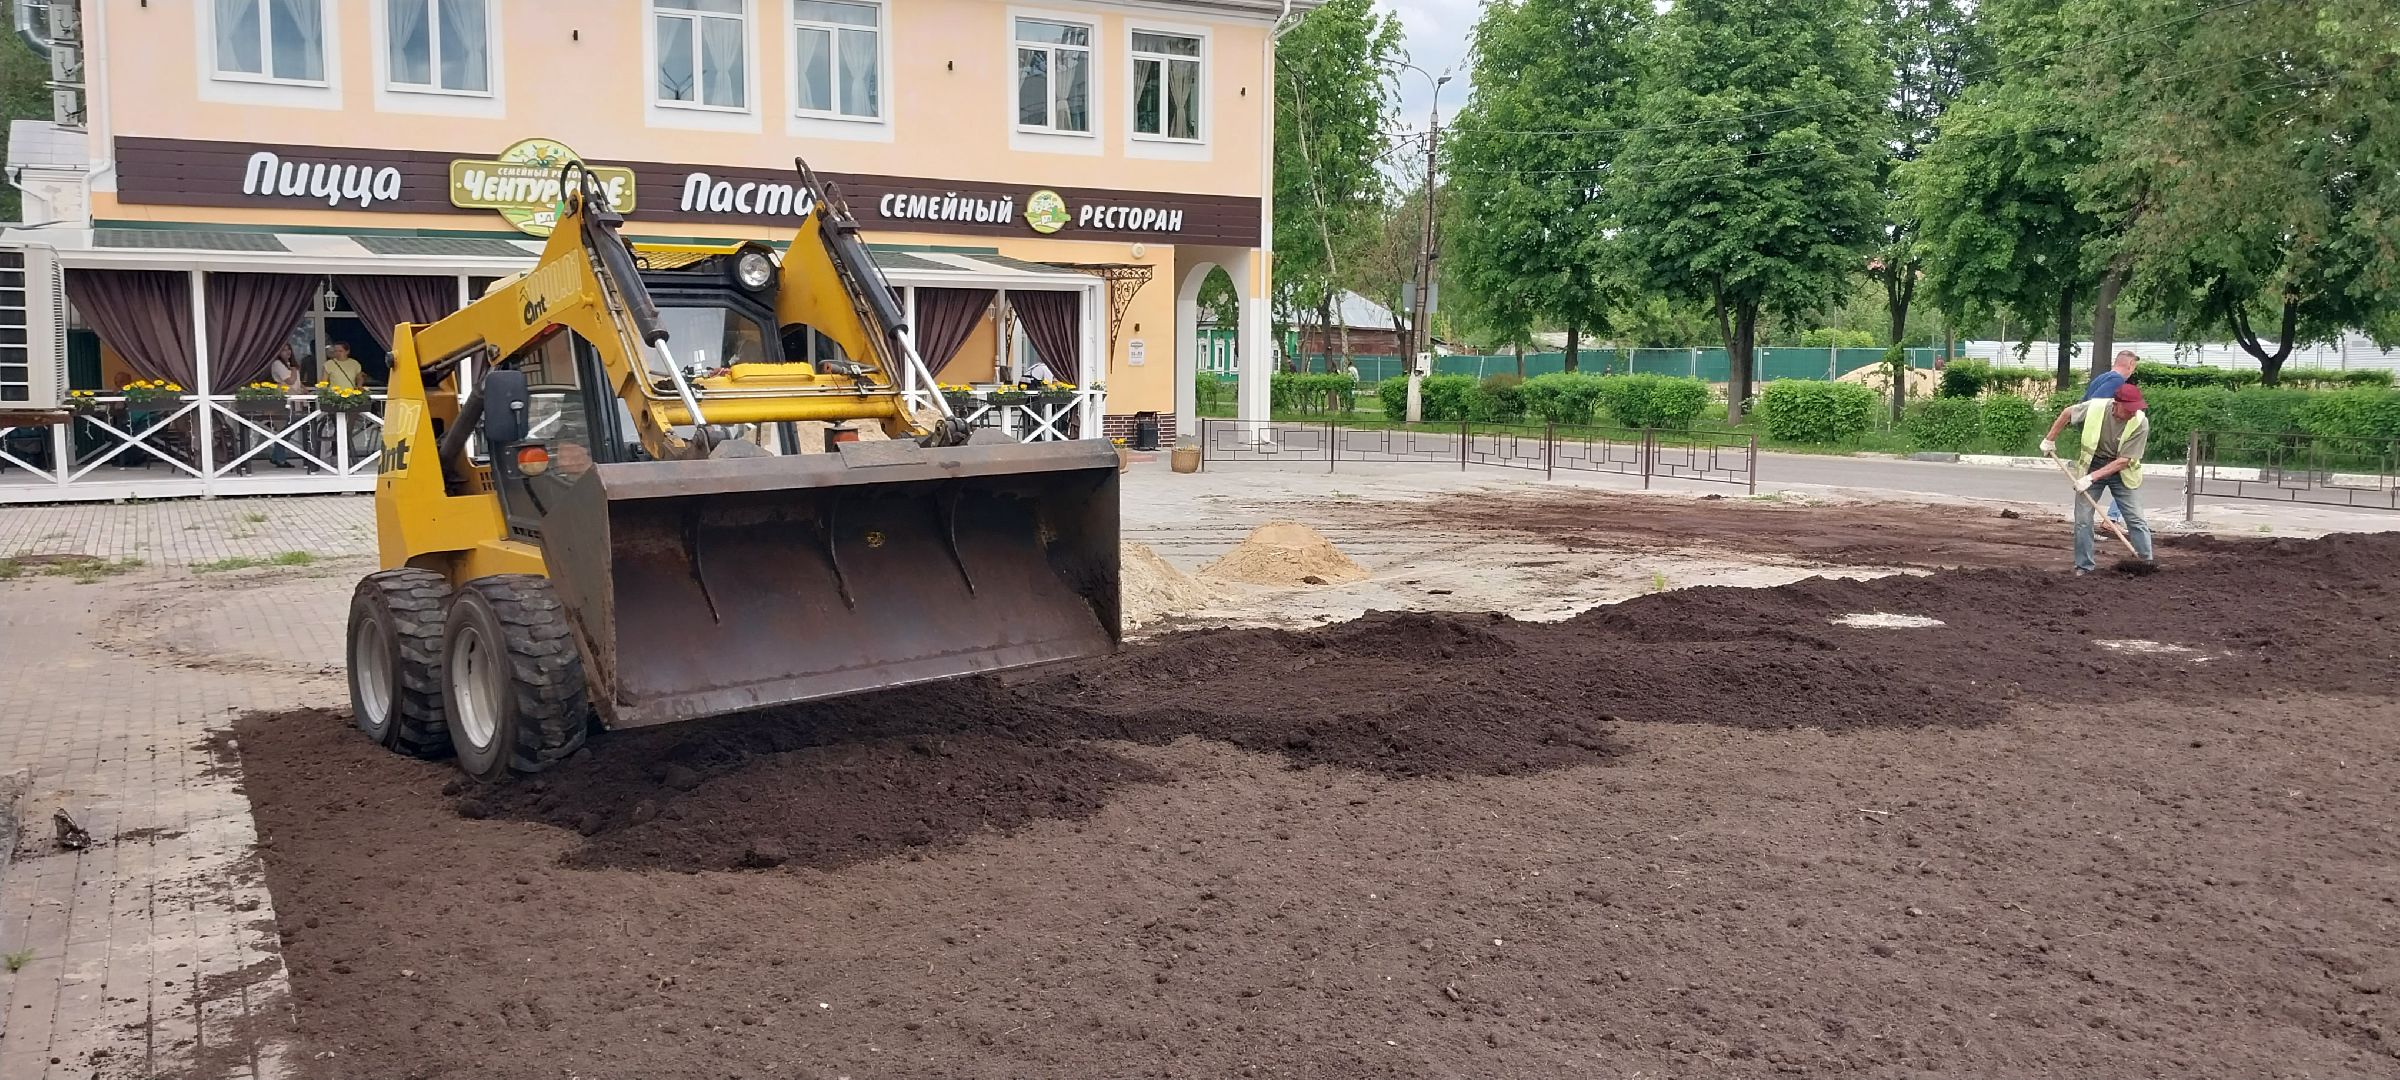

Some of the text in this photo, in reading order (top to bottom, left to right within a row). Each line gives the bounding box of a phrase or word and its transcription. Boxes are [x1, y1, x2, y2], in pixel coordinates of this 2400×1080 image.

[243, 151, 401, 208] Пицца
[498, 167, 549, 179] СЕМЕЙНЫЙ
[681, 172, 817, 216] Паста
[880, 191, 1183, 231] СЕМЕЙНЫЙ РЕСТОРАН
